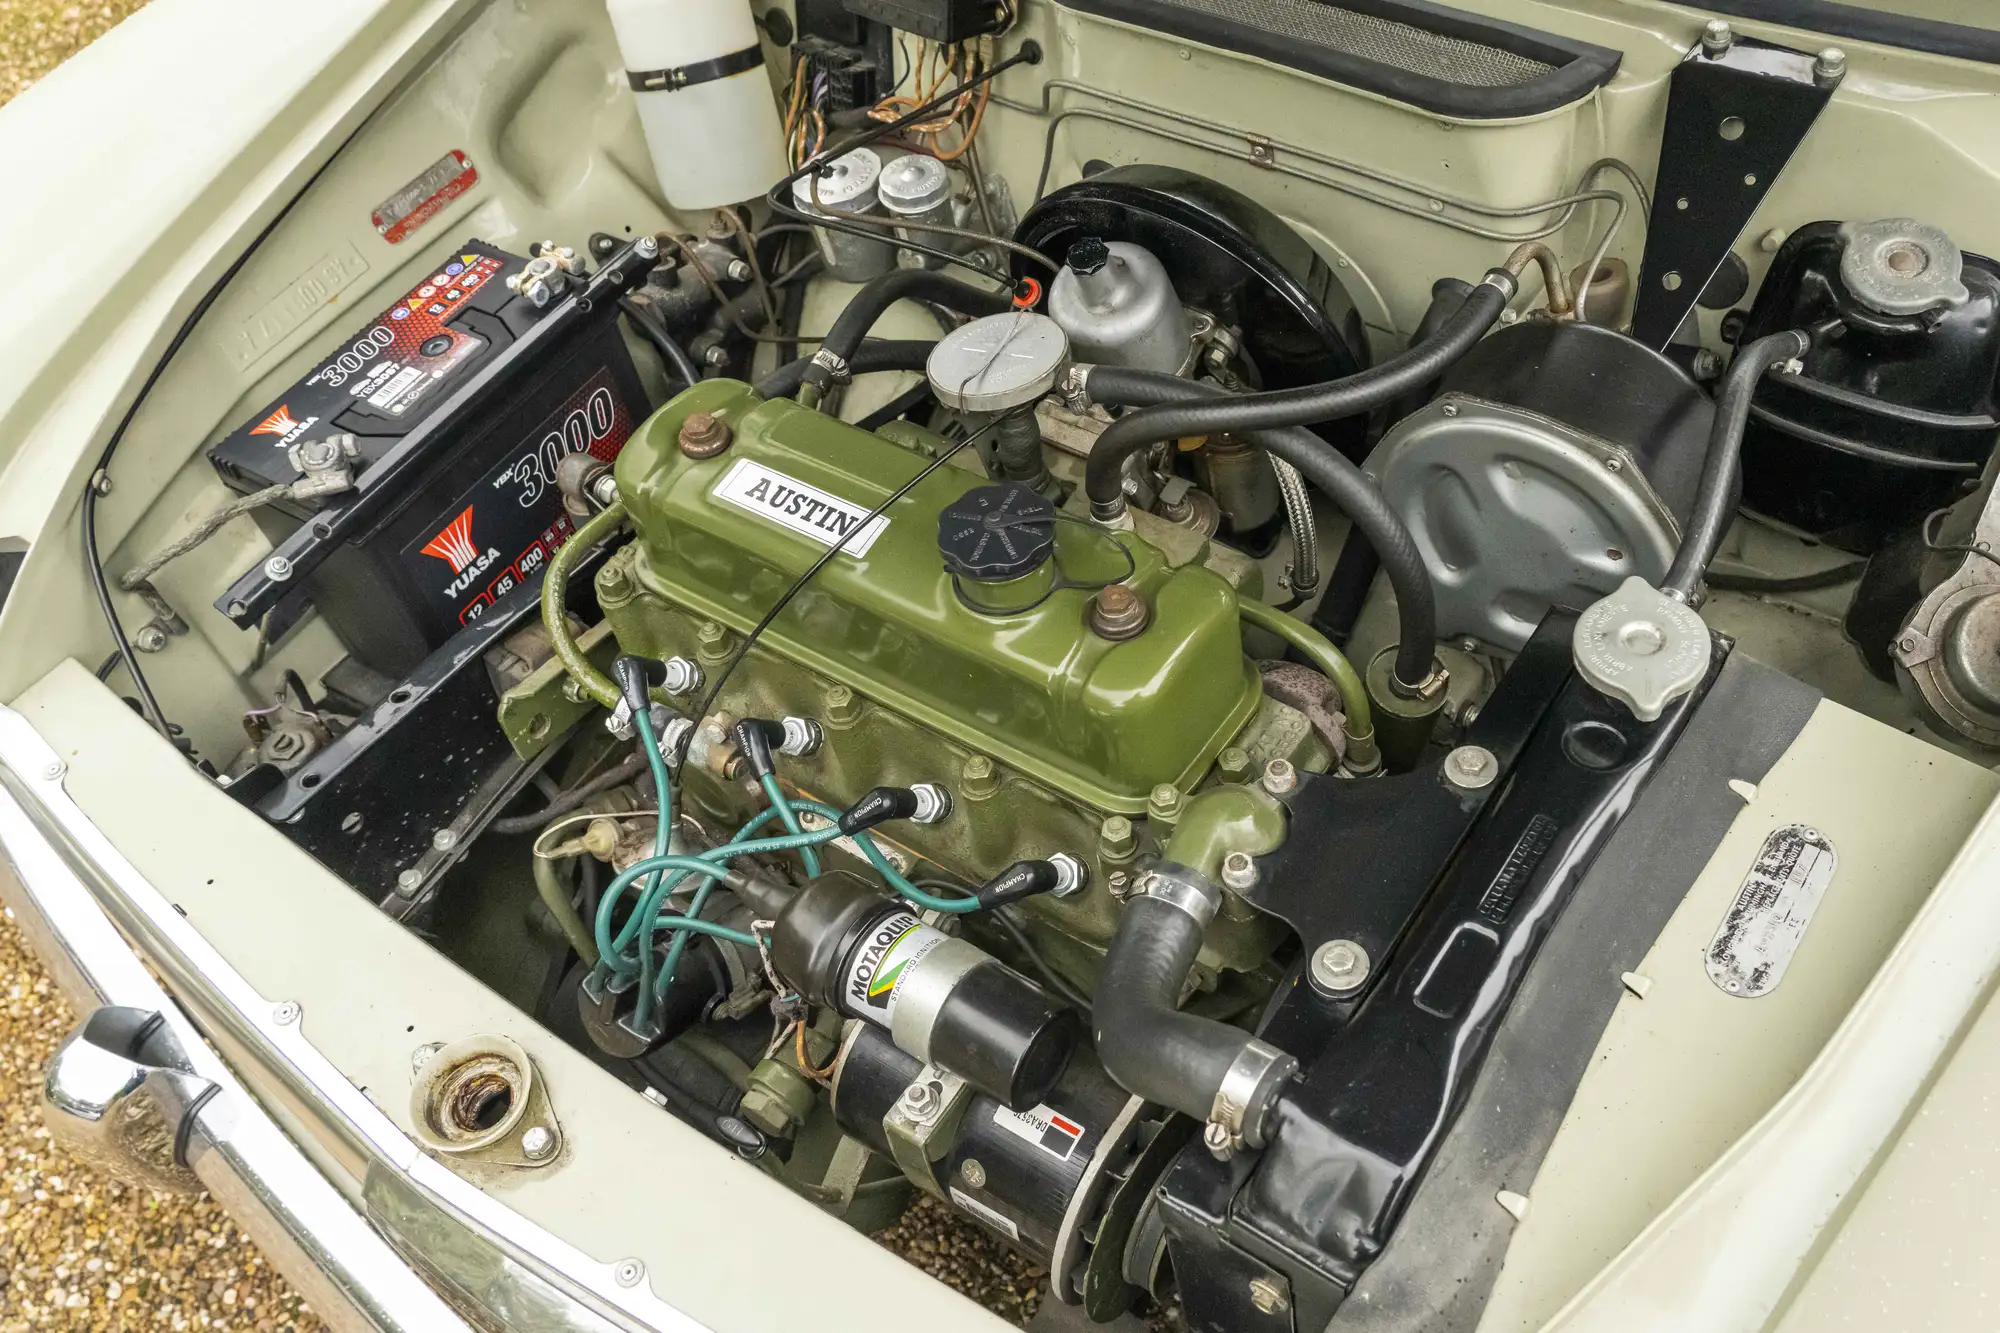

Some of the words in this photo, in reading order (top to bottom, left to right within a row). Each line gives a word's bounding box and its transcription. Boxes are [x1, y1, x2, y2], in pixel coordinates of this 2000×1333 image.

[321, 326, 395, 387] 3000
[274, 416, 320, 447] YUASA
[514, 387, 615, 508] 3000
[744, 477, 860, 537] AUSTIN
[443, 547, 501, 599] YUASA
[521, 547, 544, 574] 400
[497, 576, 513, 596] 45
[468, 603, 483, 620] 12
[736, 725, 752, 758] CHAMPION
[854, 797, 882, 819] CHAMPION
[995, 873, 1026, 893] CHAMPION
[851, 915, 914, 1002] MOTAQUIP
[891, 960, 917, 1001] STANDARD
